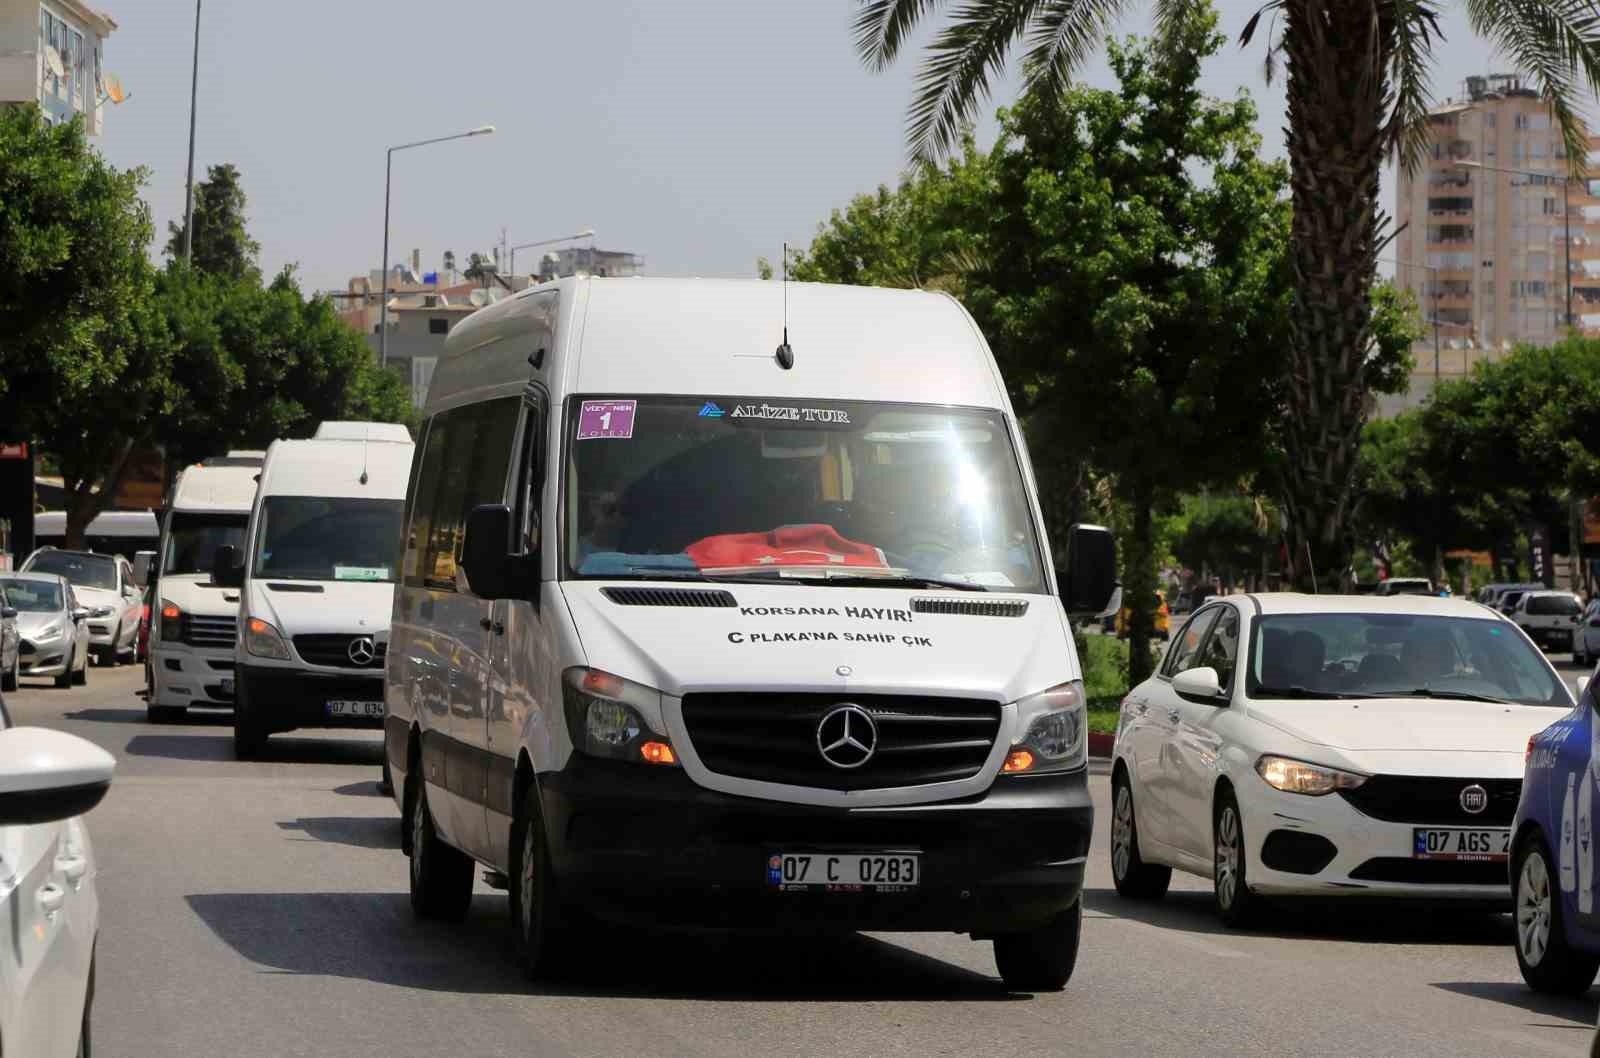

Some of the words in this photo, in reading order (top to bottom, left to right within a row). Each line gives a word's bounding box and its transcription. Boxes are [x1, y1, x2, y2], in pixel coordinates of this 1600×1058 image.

[600, 412, 611, 430] 1
[731, 403, 800, 420] ALİZE
[802, 408, 850, 423] TUR
[740, 607, 840, 616] KORSANA
[844, 606, 913, 622] HAYIR!
[727, 632, 744, 643] C
[750, 632, 838, 643] PLAKA'NA
[843, 632, 896, 643] SAHİP
[901, 635, 932, 647] ÇIK
[1428, 832, 1450, 852] 07
[1458, 832, 1490, 853] AGS
[784, 856, 811, 881] 07
[827, 857, 840, 881] C
[859, 857, 914, 882] 0283
